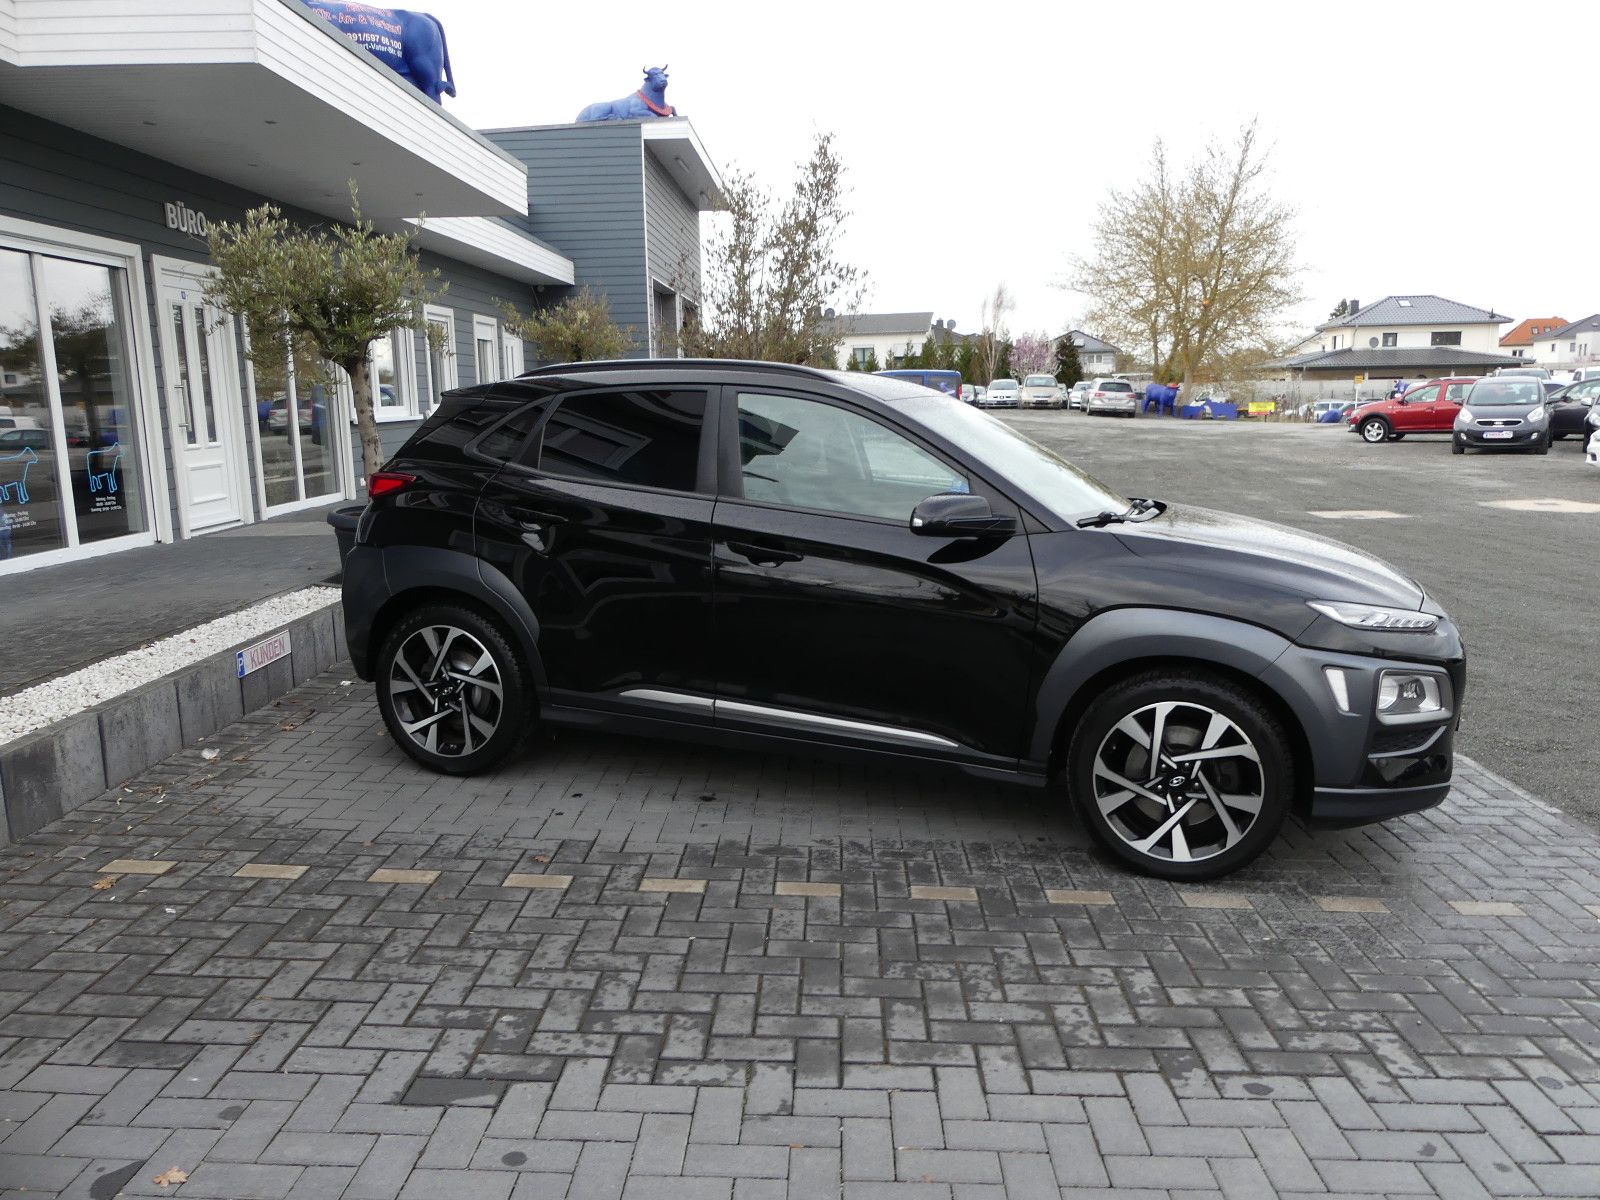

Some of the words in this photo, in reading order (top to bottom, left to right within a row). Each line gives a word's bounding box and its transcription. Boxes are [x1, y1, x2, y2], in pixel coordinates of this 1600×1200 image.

[391, 40, 401, 50] 100
[164, 201, 206, 236] BÜRO
[249, 636, 285, 669] KUNDEN
